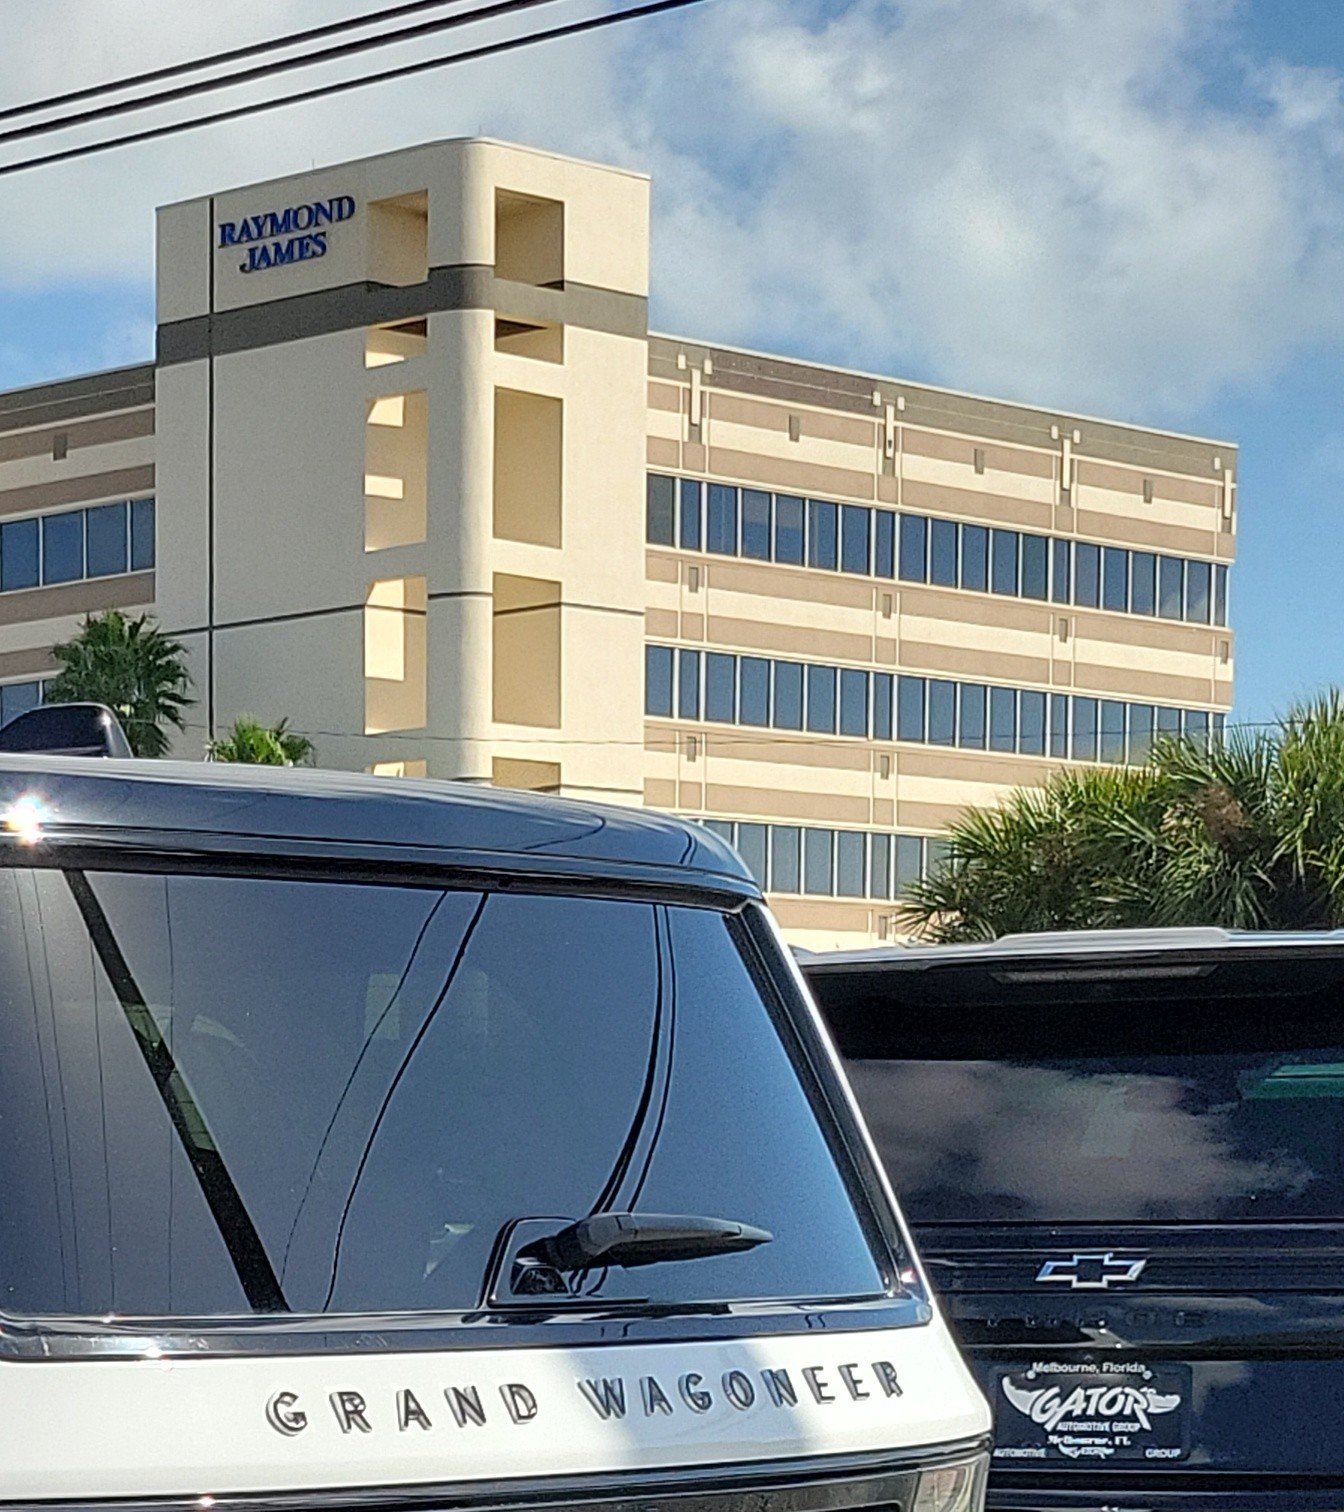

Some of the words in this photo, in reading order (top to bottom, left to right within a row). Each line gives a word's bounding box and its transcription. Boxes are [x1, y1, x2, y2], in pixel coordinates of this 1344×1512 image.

[218, 195, 356, 248] RAYMOND
[239, 231, 327, 273] JAMES
[1032, 1362, 1099, 1374] Melbourne,
[1102, 1362, 1145, 1373] Florida
[265, 1383, 538, 1436] GRAND
[577, 1360, 904, 1421] WAGONEER
[1031, 1386, 1152, 1432] GATOR
[1145, 1447, 1181, 1458] GROUP
